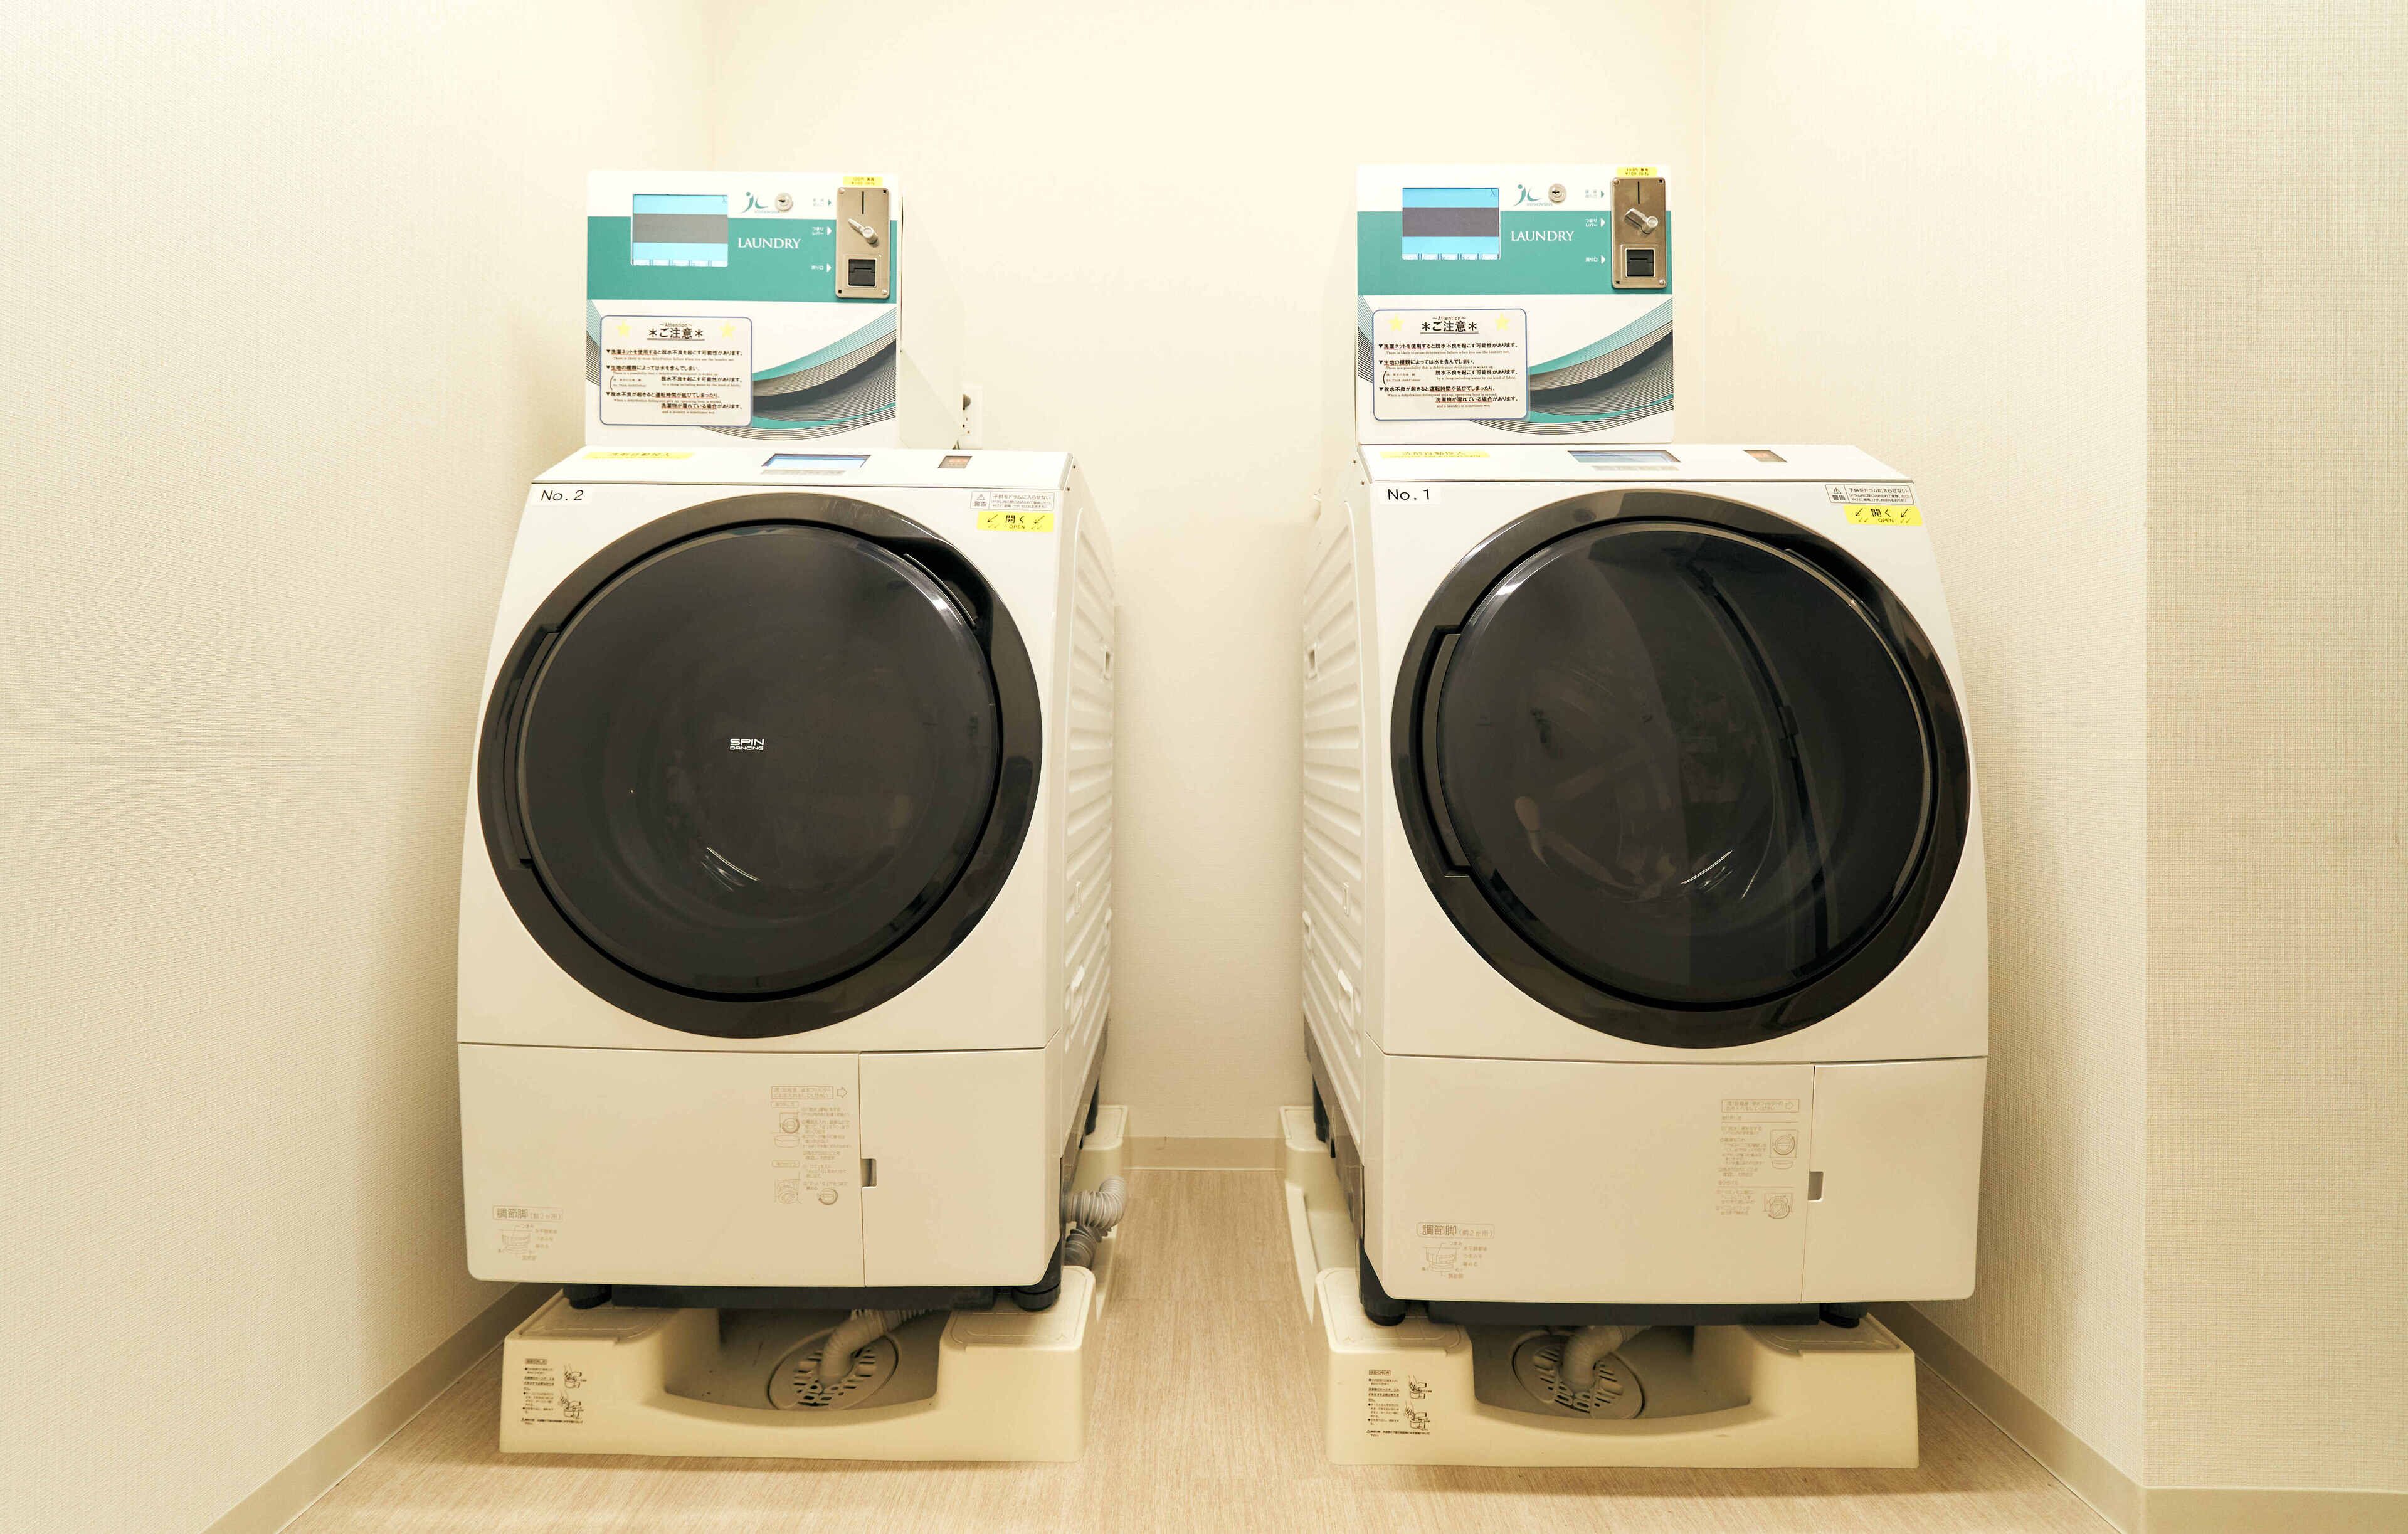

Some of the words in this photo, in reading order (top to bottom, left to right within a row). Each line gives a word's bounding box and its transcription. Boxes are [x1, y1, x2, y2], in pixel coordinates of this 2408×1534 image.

[1511, 231, 1575, 241] LAUNDRY
[738, 238, 801, 249] LAUNDRY
[1871, 508, 1891, 517] 開く
[1005, 515, 1025, 523] 開く
[1422, 1225, 1457, 1235] 調節脚
